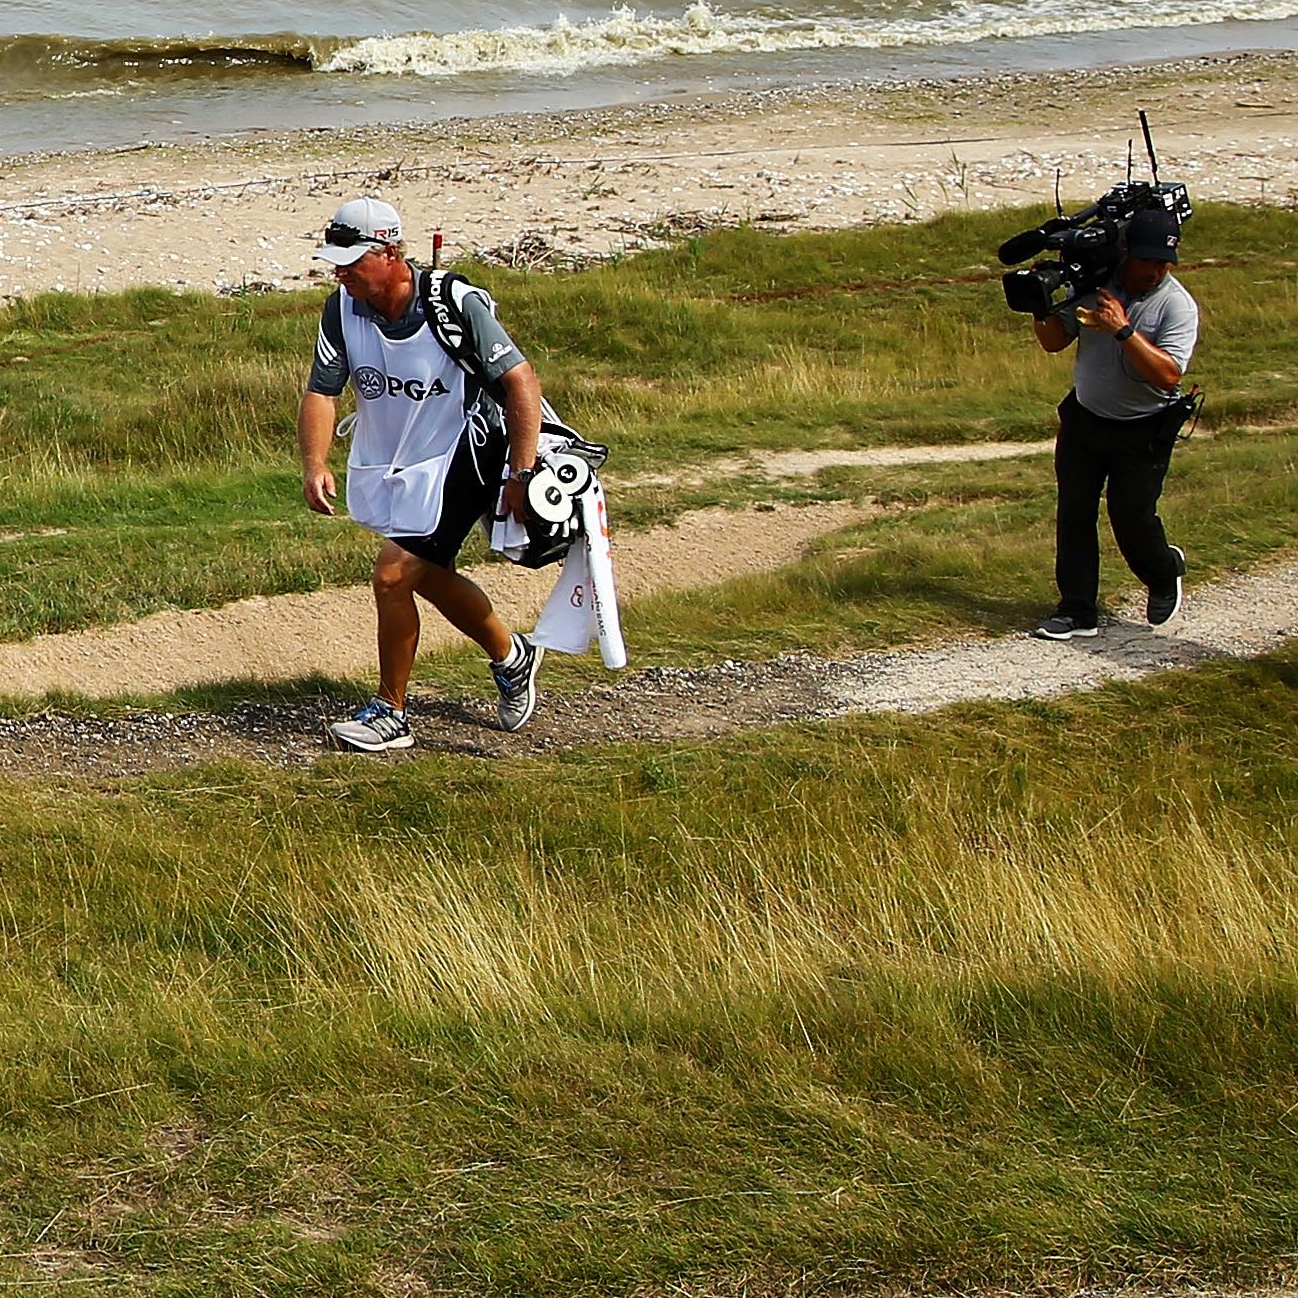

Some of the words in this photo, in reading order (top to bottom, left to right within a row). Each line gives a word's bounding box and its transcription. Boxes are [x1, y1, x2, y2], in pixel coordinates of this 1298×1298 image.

[372, 226, 399, 239] R15
[386, 376, 451, 401] PGA
[560, 468, 573, 479] 3
